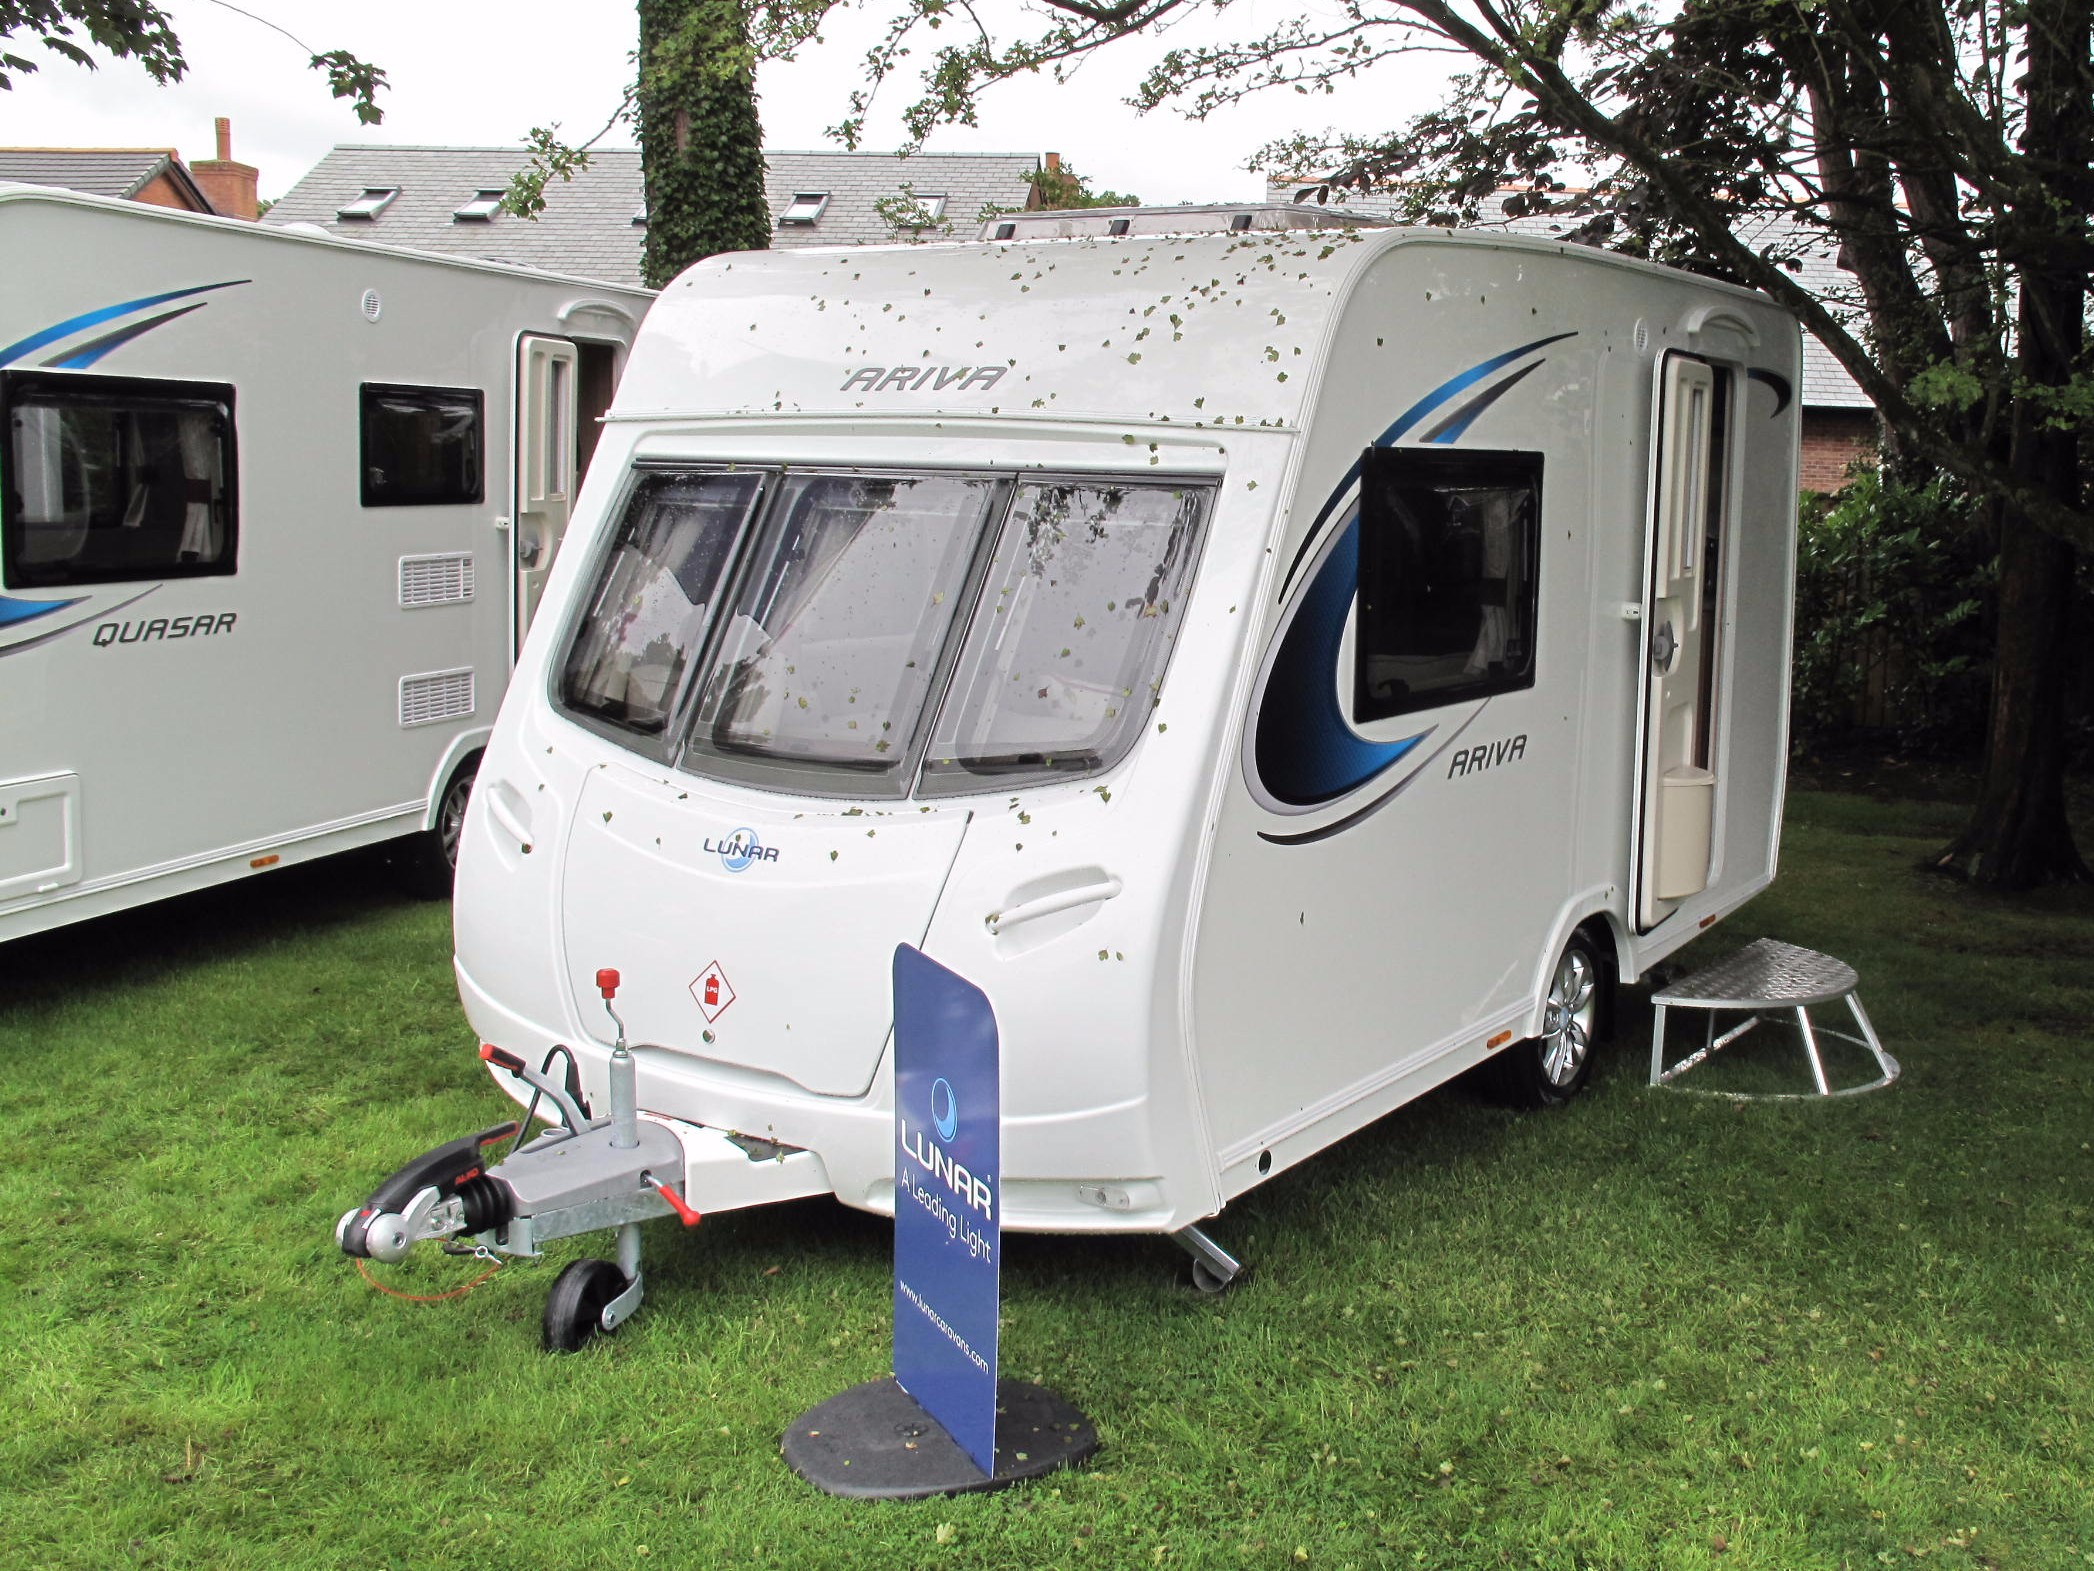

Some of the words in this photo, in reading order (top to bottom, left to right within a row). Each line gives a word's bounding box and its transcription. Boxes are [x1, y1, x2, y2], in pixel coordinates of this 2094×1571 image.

[840, 366, 1008, 392] ARIVA
[92, 612, 238, 648] QUASAR
[1447, 733, 1528, 780] ARIVA
[703, 837, 780, 863] LUNAR
[901, 1118, 992, 1221] LUNAR
[901, 1167, 911, 1193] A
[912, 1173, 957, 1239] Leading
[960, 1214, 991, 1264] Light
[900, 1279, 989, 1375] www.lunarcaravans.com
